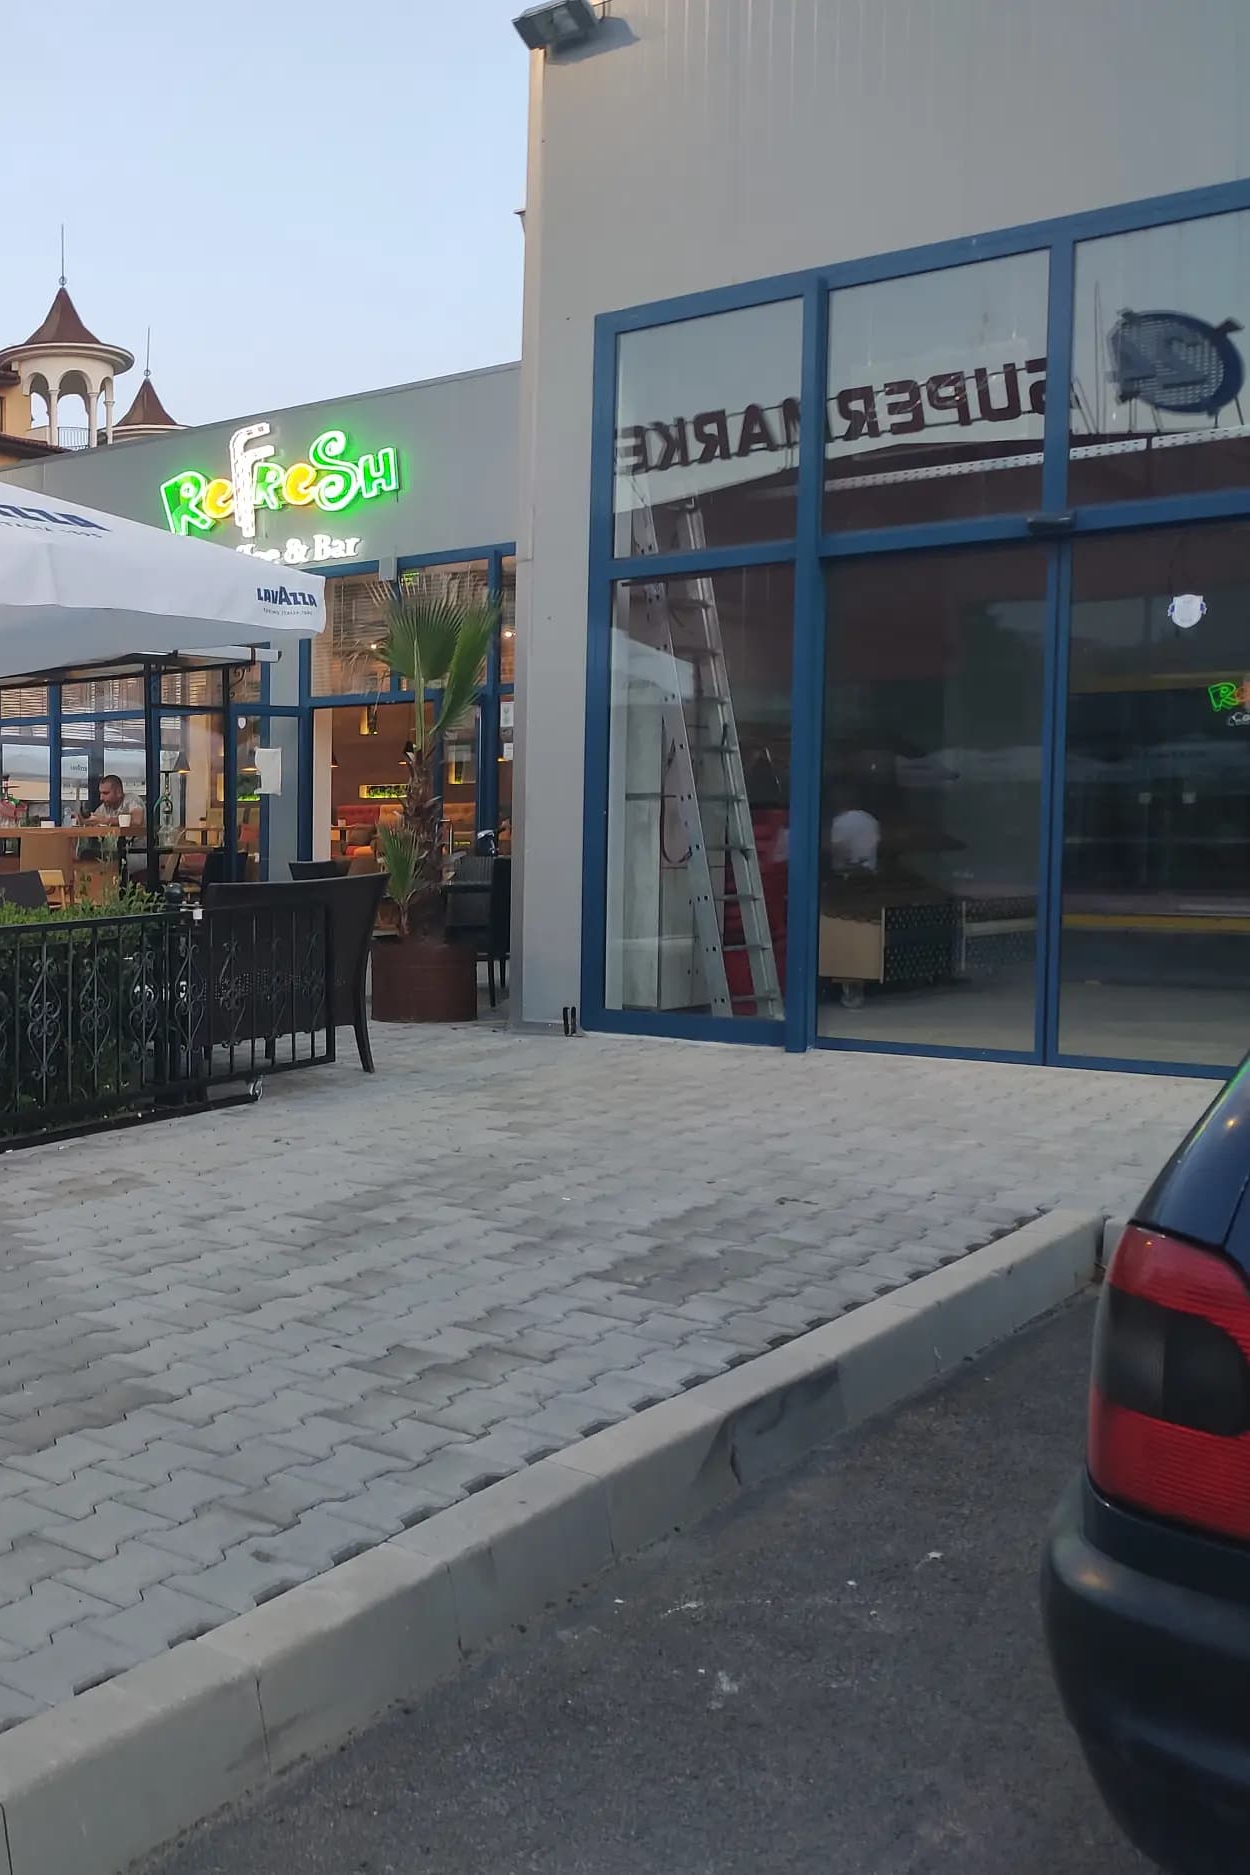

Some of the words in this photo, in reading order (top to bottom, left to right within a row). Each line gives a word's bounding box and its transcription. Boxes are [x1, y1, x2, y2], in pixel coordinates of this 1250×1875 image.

[283, 538, 310, 564] &
[312, 534, 362, 561] Bar
[257, 585, 317, 607] LAVAZZA
